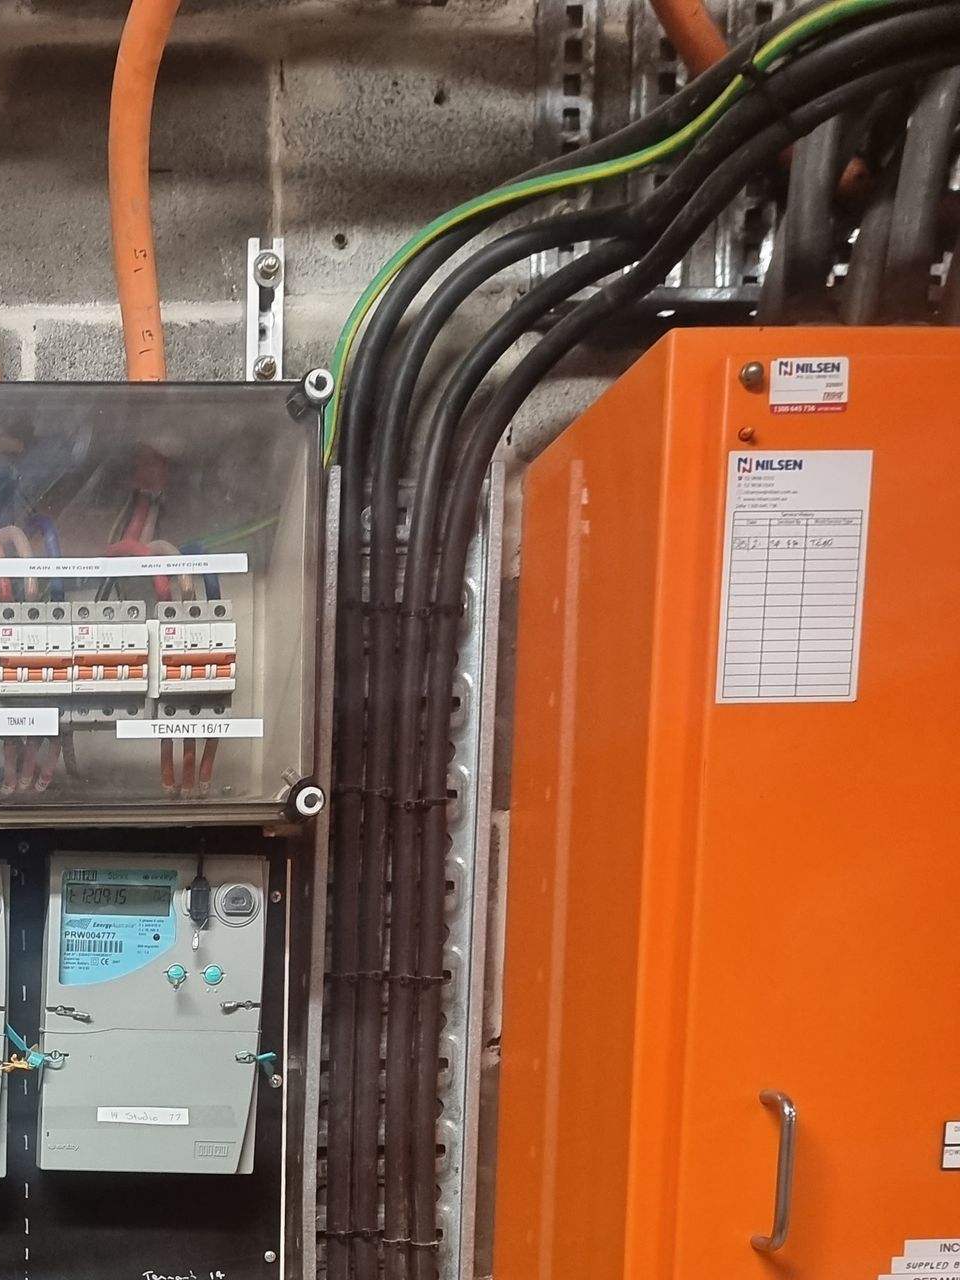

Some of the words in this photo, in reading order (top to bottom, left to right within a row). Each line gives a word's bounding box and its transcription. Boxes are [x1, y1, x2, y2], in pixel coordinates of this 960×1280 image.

[796, 362, 840, 373] NILSEN
[755, 459, 803, 471] NILSEN
[7, 717, 26, 726] TENANT
[28, 717, 35, 725] 14
[151, 724, 197, 734] TENANT
[201, 723, 230, 734] 16/17
[64, 931, 116, 940] PRW004777
[125, 1112, 159, 1122] Studio
[939, 1243, 960, 1253] INC
[905, 1262, 949, 1270] SUPPLED
